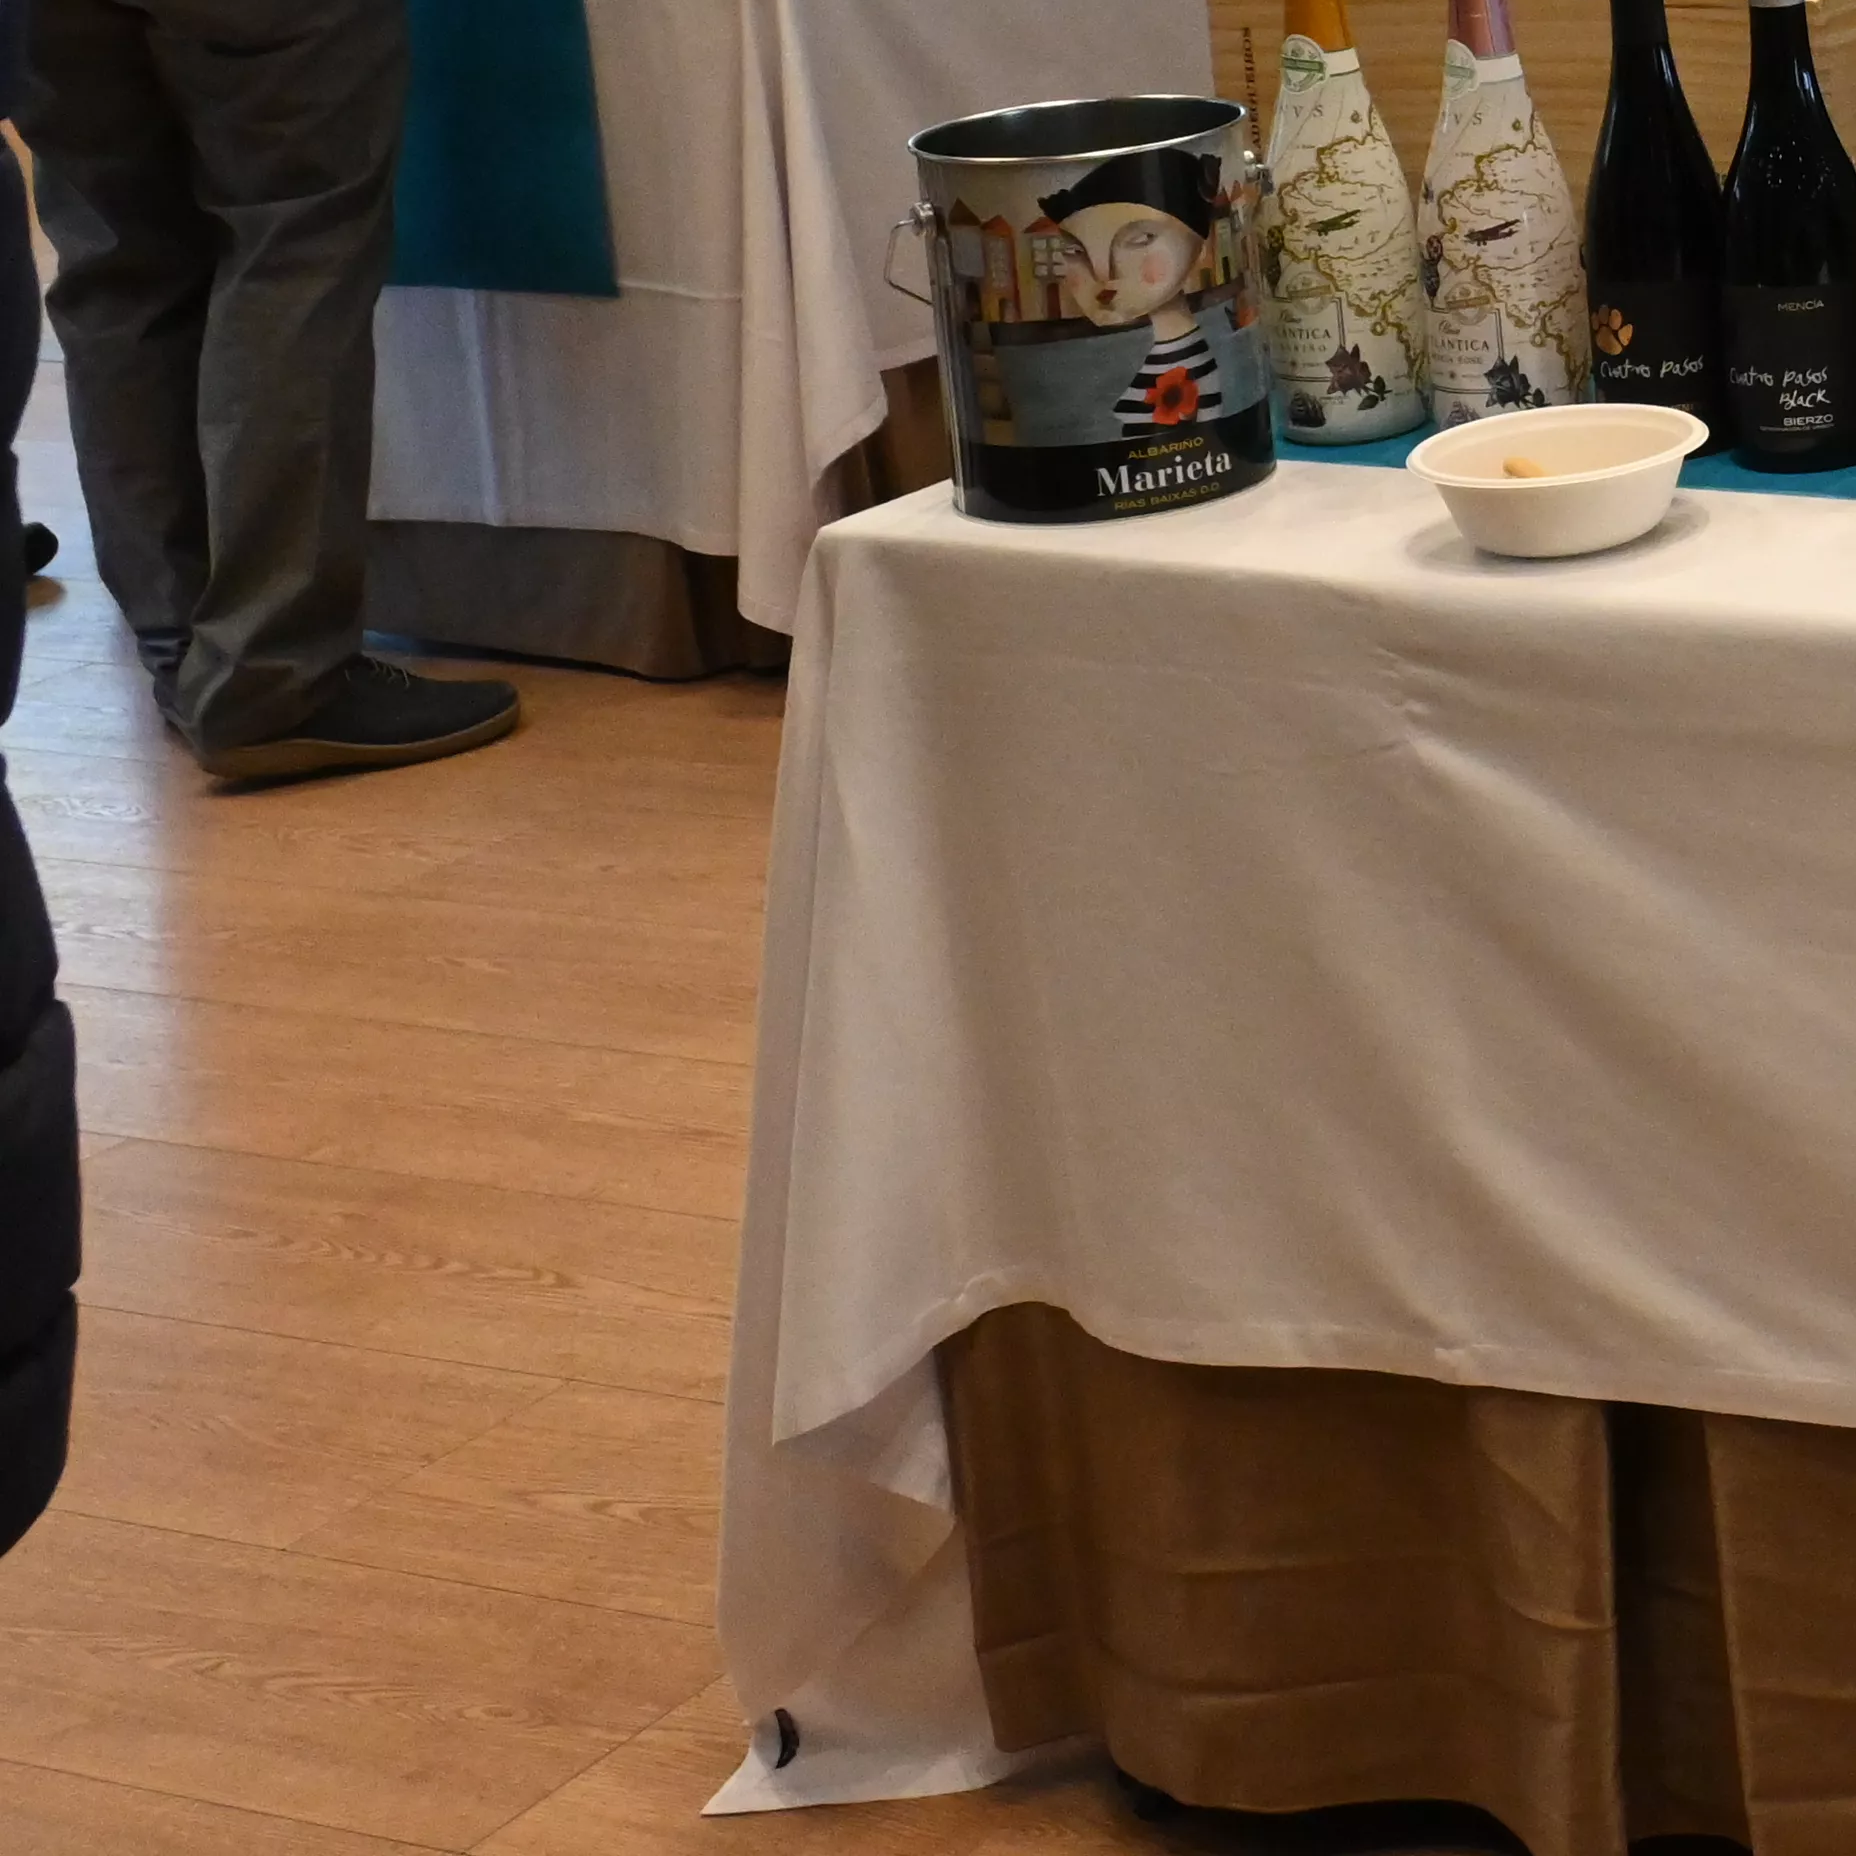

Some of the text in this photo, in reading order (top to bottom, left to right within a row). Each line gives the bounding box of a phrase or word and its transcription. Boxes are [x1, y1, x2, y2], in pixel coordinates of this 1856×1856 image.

[1777, 299, 1825, 312] MENCÍA
[1783, 413, 1834, 426] BIERZO
[1128, 436, 1205, 461] ALBARIÑO
[1096, 449, 1233, 498] Marieta
[1150, 487, 1198, 506] BAIXAS
